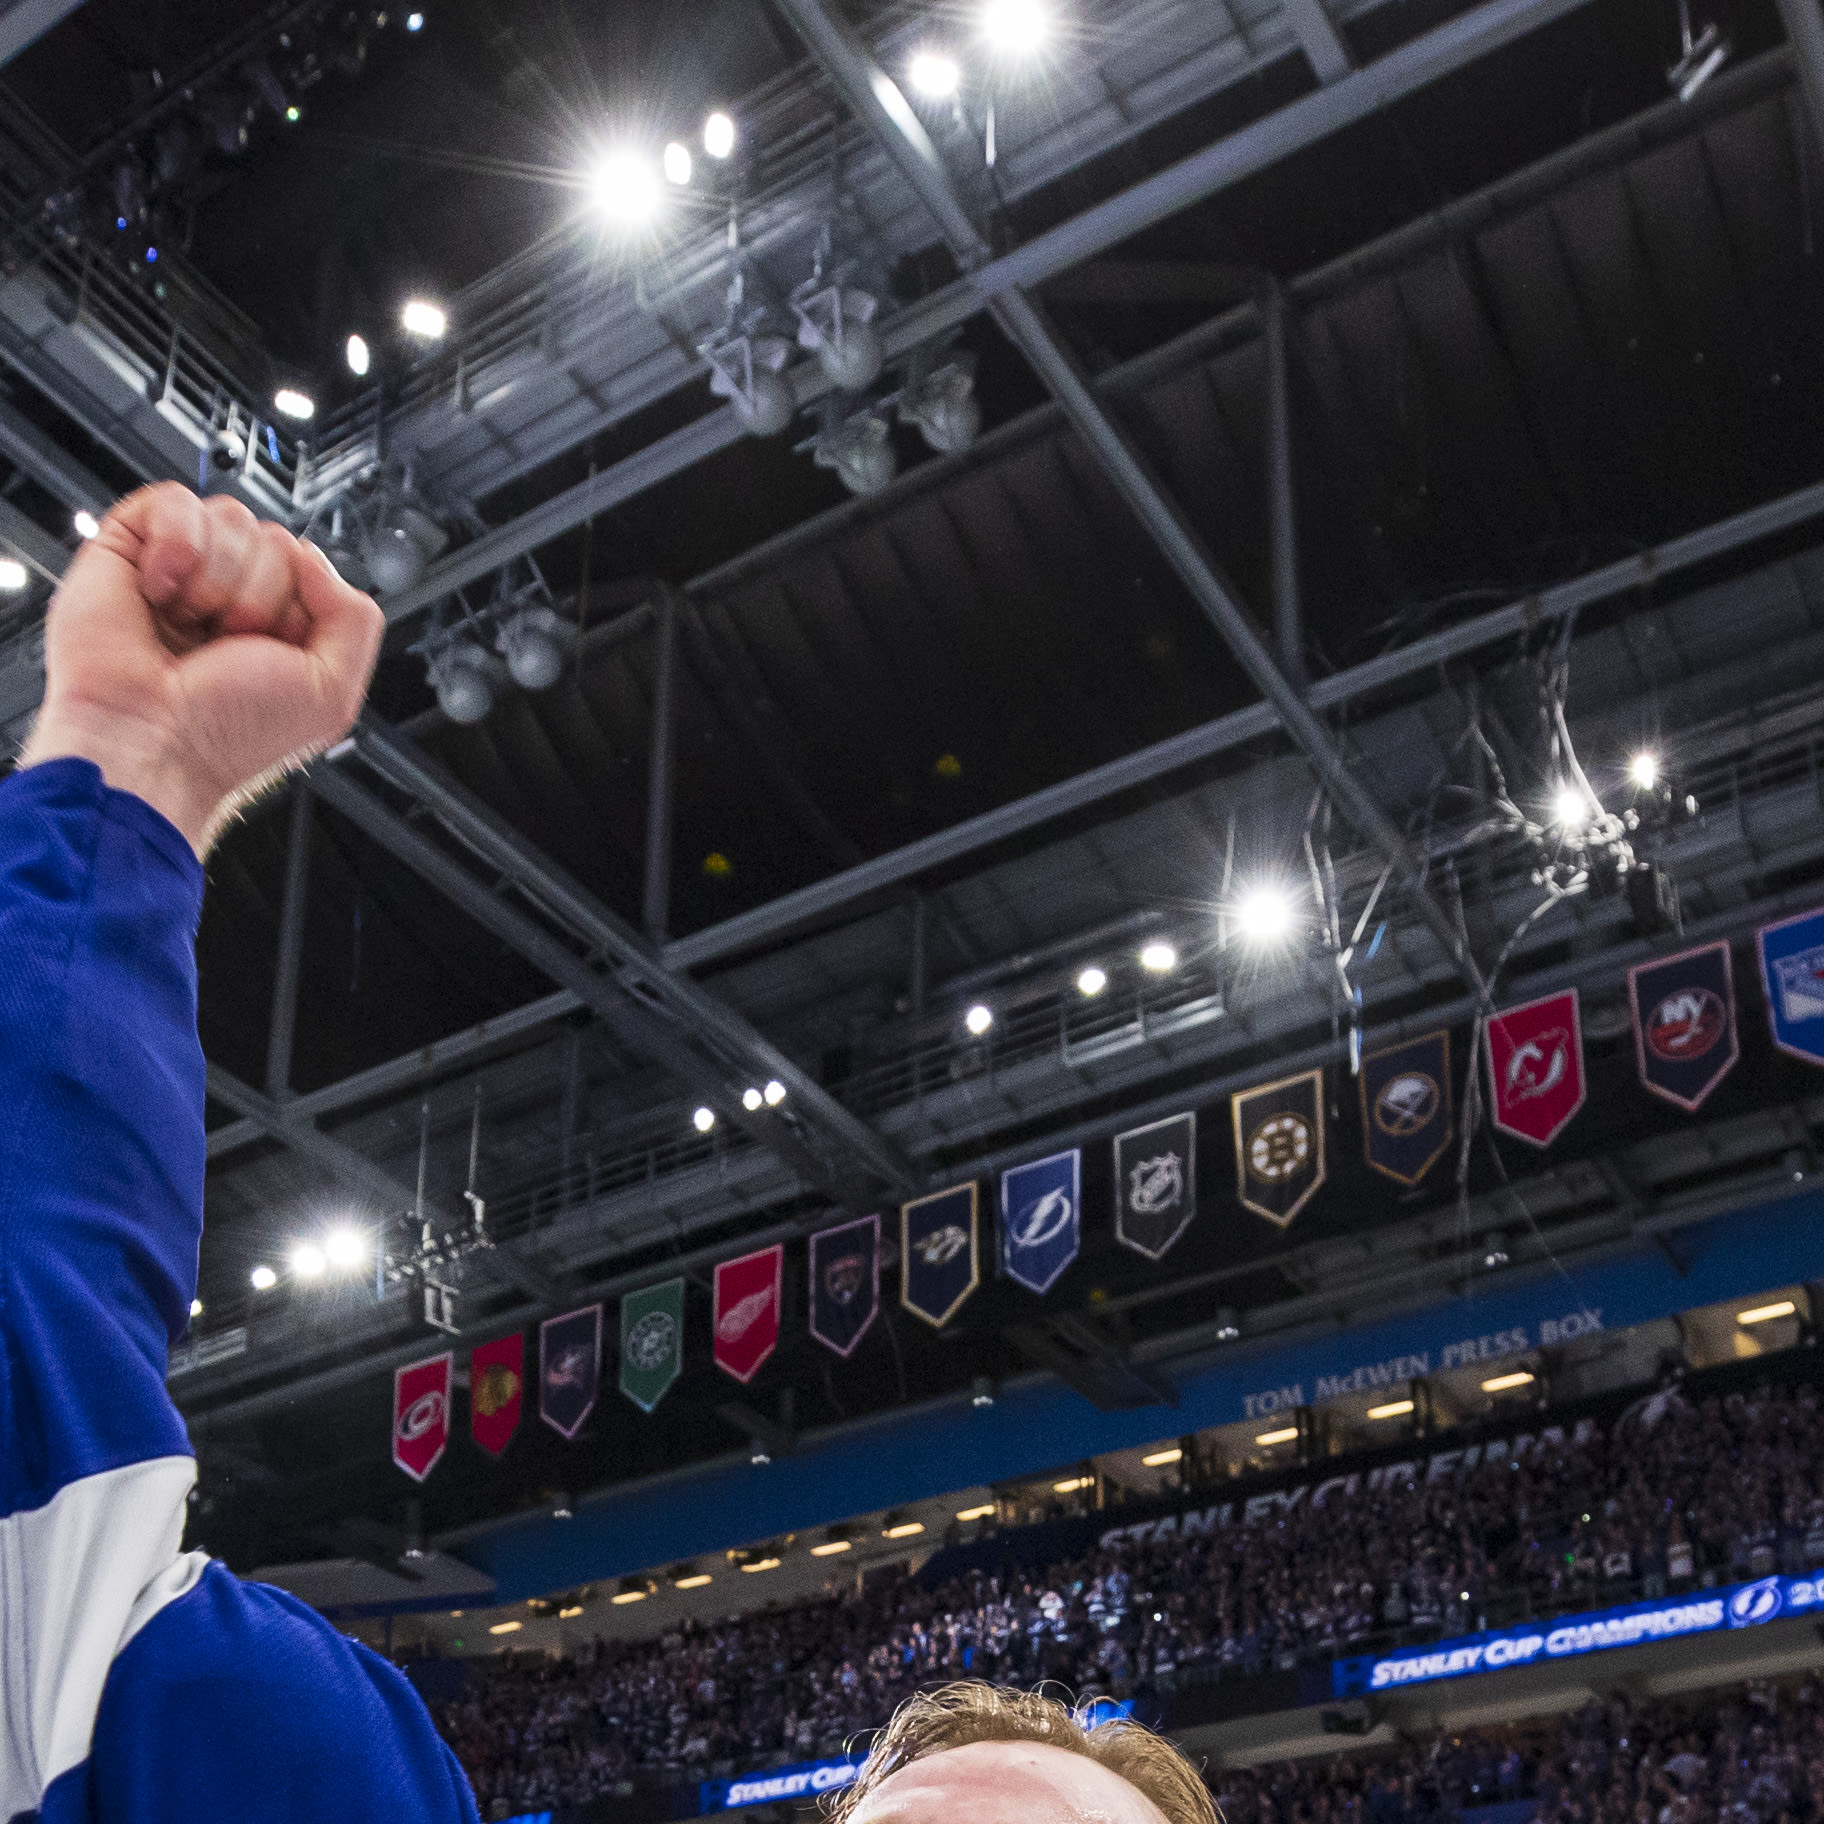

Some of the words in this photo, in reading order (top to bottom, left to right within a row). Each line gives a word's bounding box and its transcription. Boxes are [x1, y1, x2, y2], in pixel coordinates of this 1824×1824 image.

[1242, 1382, 1304, 1418] TOM
[1442, 1327, 1529, 1369] PRESS
[1539, 1307, 1606, 1346] BOX
[1370, 1646, 1482, 1688] STANLEY
[1484, 1634, 1545, 1666] CUP
[1546, 1600, 1726, 1656] CHAMPIONS
[727, 1775, 809, 1806] STANLEY
